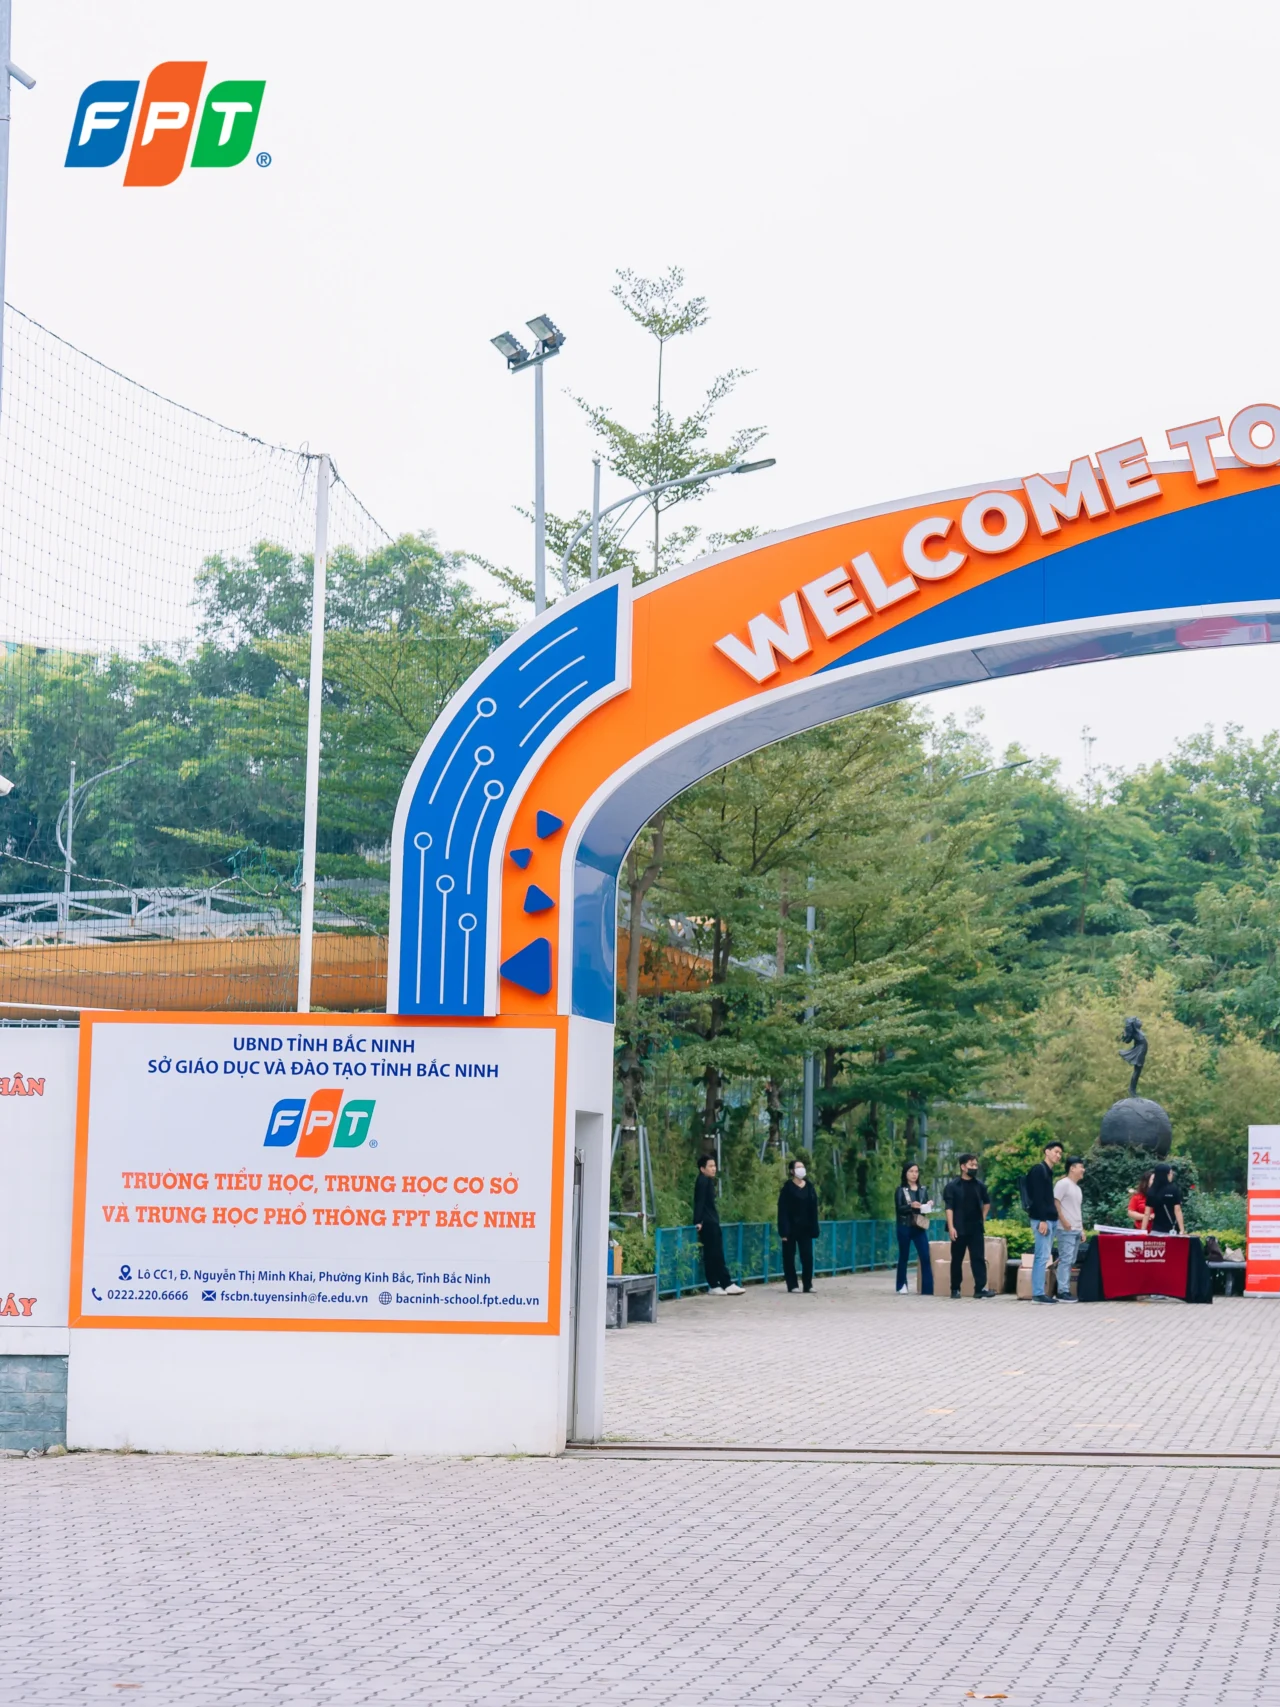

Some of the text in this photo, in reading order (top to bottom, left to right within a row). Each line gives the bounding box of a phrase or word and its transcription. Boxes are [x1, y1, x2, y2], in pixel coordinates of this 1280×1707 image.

[713, 437, 1163, 684] WELCOME
[233, 1034, 415, 1053] UBND TỈNH BẮC NINH
[148, 1056, 499, 1080] SỞ GIÁO DỤC VÀ ĐÀO TẠO TỈNH BẮC NINH
[1252, 1151, 1271, 1165] 24
[121, 1167, 519, 1197] TRƯỜNG TIỂU HỌC, TRUNG HỌC CƠ SỞ
[102, 1201, 536, 1228] VÀ TRUNG HỌC PHỔ THÔNG FPT BẮC NINH
[1144, 1250, 1166, 1258] BUV
[138, 1268, 491, 1285] Lô CC1, Đ. Nguyễn Thị Minh Khai, Phường Kinh Bắc, Tỉnh Bắc Ninh
[0, 1292, 37, 1316] ÁY
[107, 1290, 540, 1307] 0222.220.6666 fscbn.tuyensinh@fe.edu.vn bacninh-school.fpt.edu.vn
